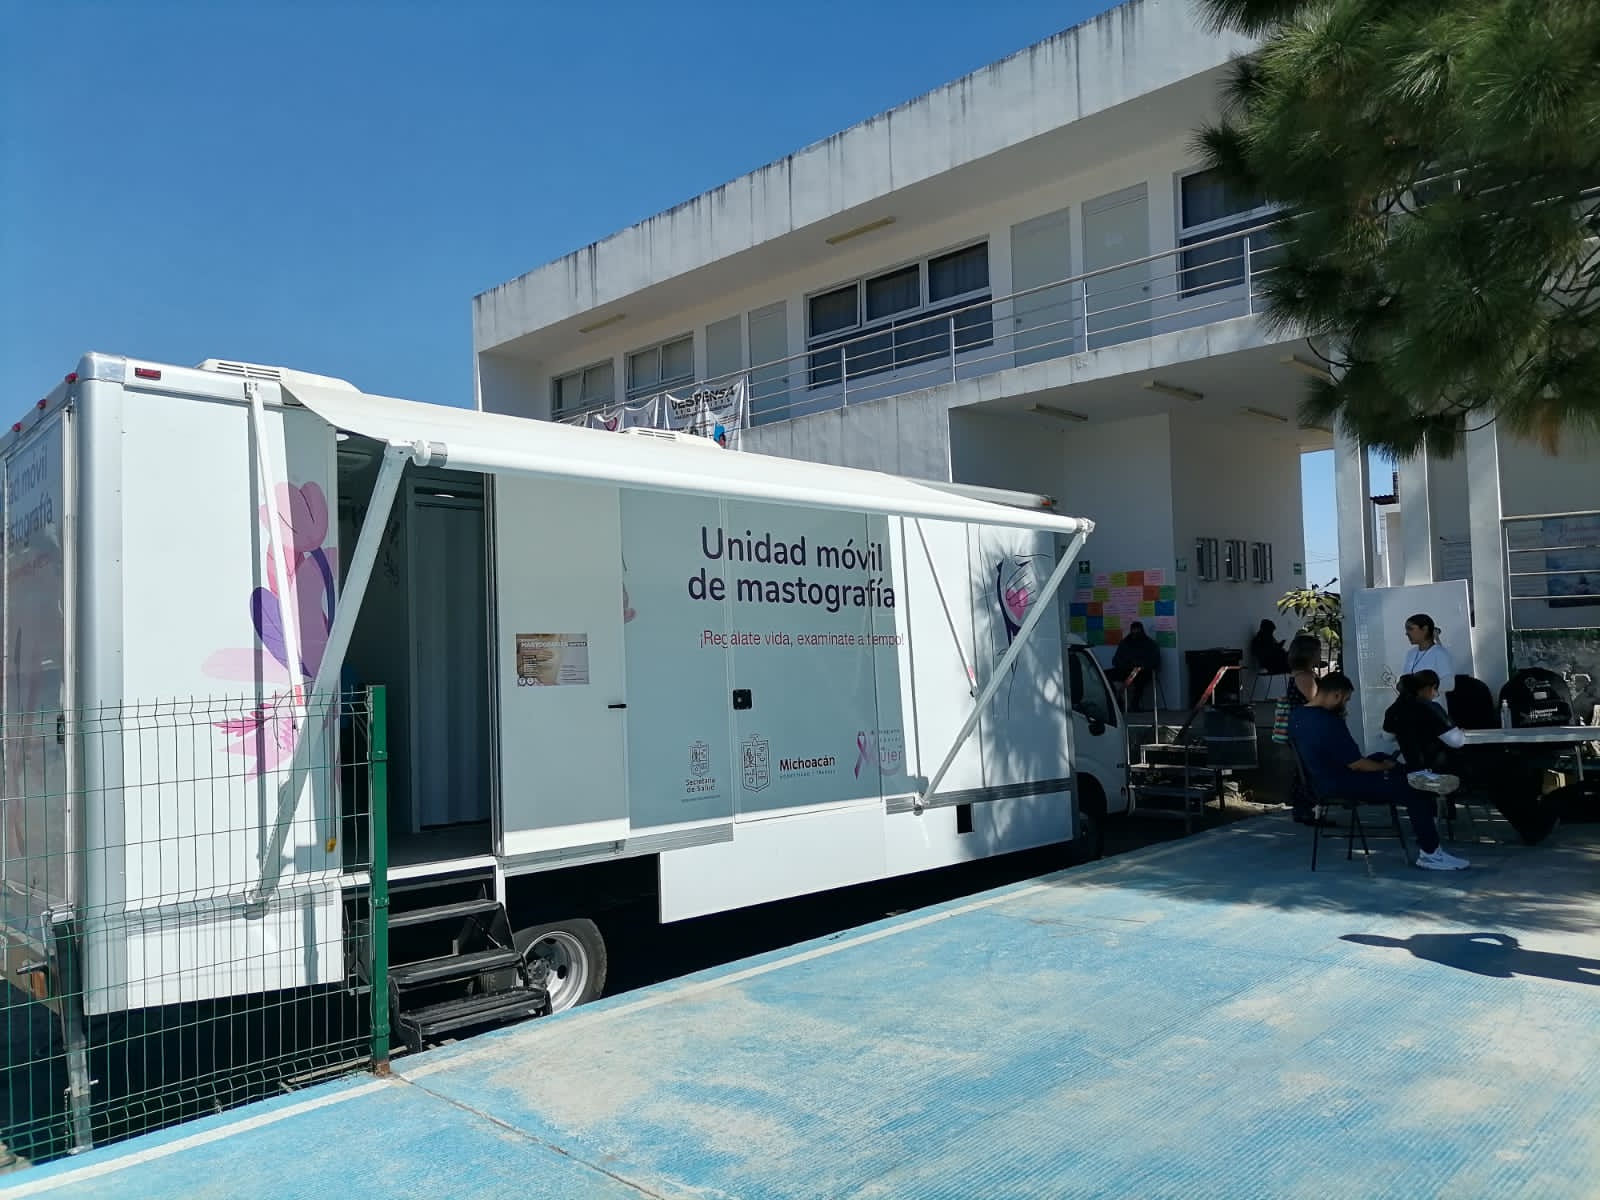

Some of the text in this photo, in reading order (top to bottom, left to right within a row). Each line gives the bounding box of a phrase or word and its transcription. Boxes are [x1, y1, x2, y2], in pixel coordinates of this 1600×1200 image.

[702, 526, 882, 572] Unidad móvil
[688, 567, 896, 613] de mastografía
[765, 631, 793, 647] vida,
[858, 635, 864, 645] a
[779, 754, 836, 771] Michoacán
